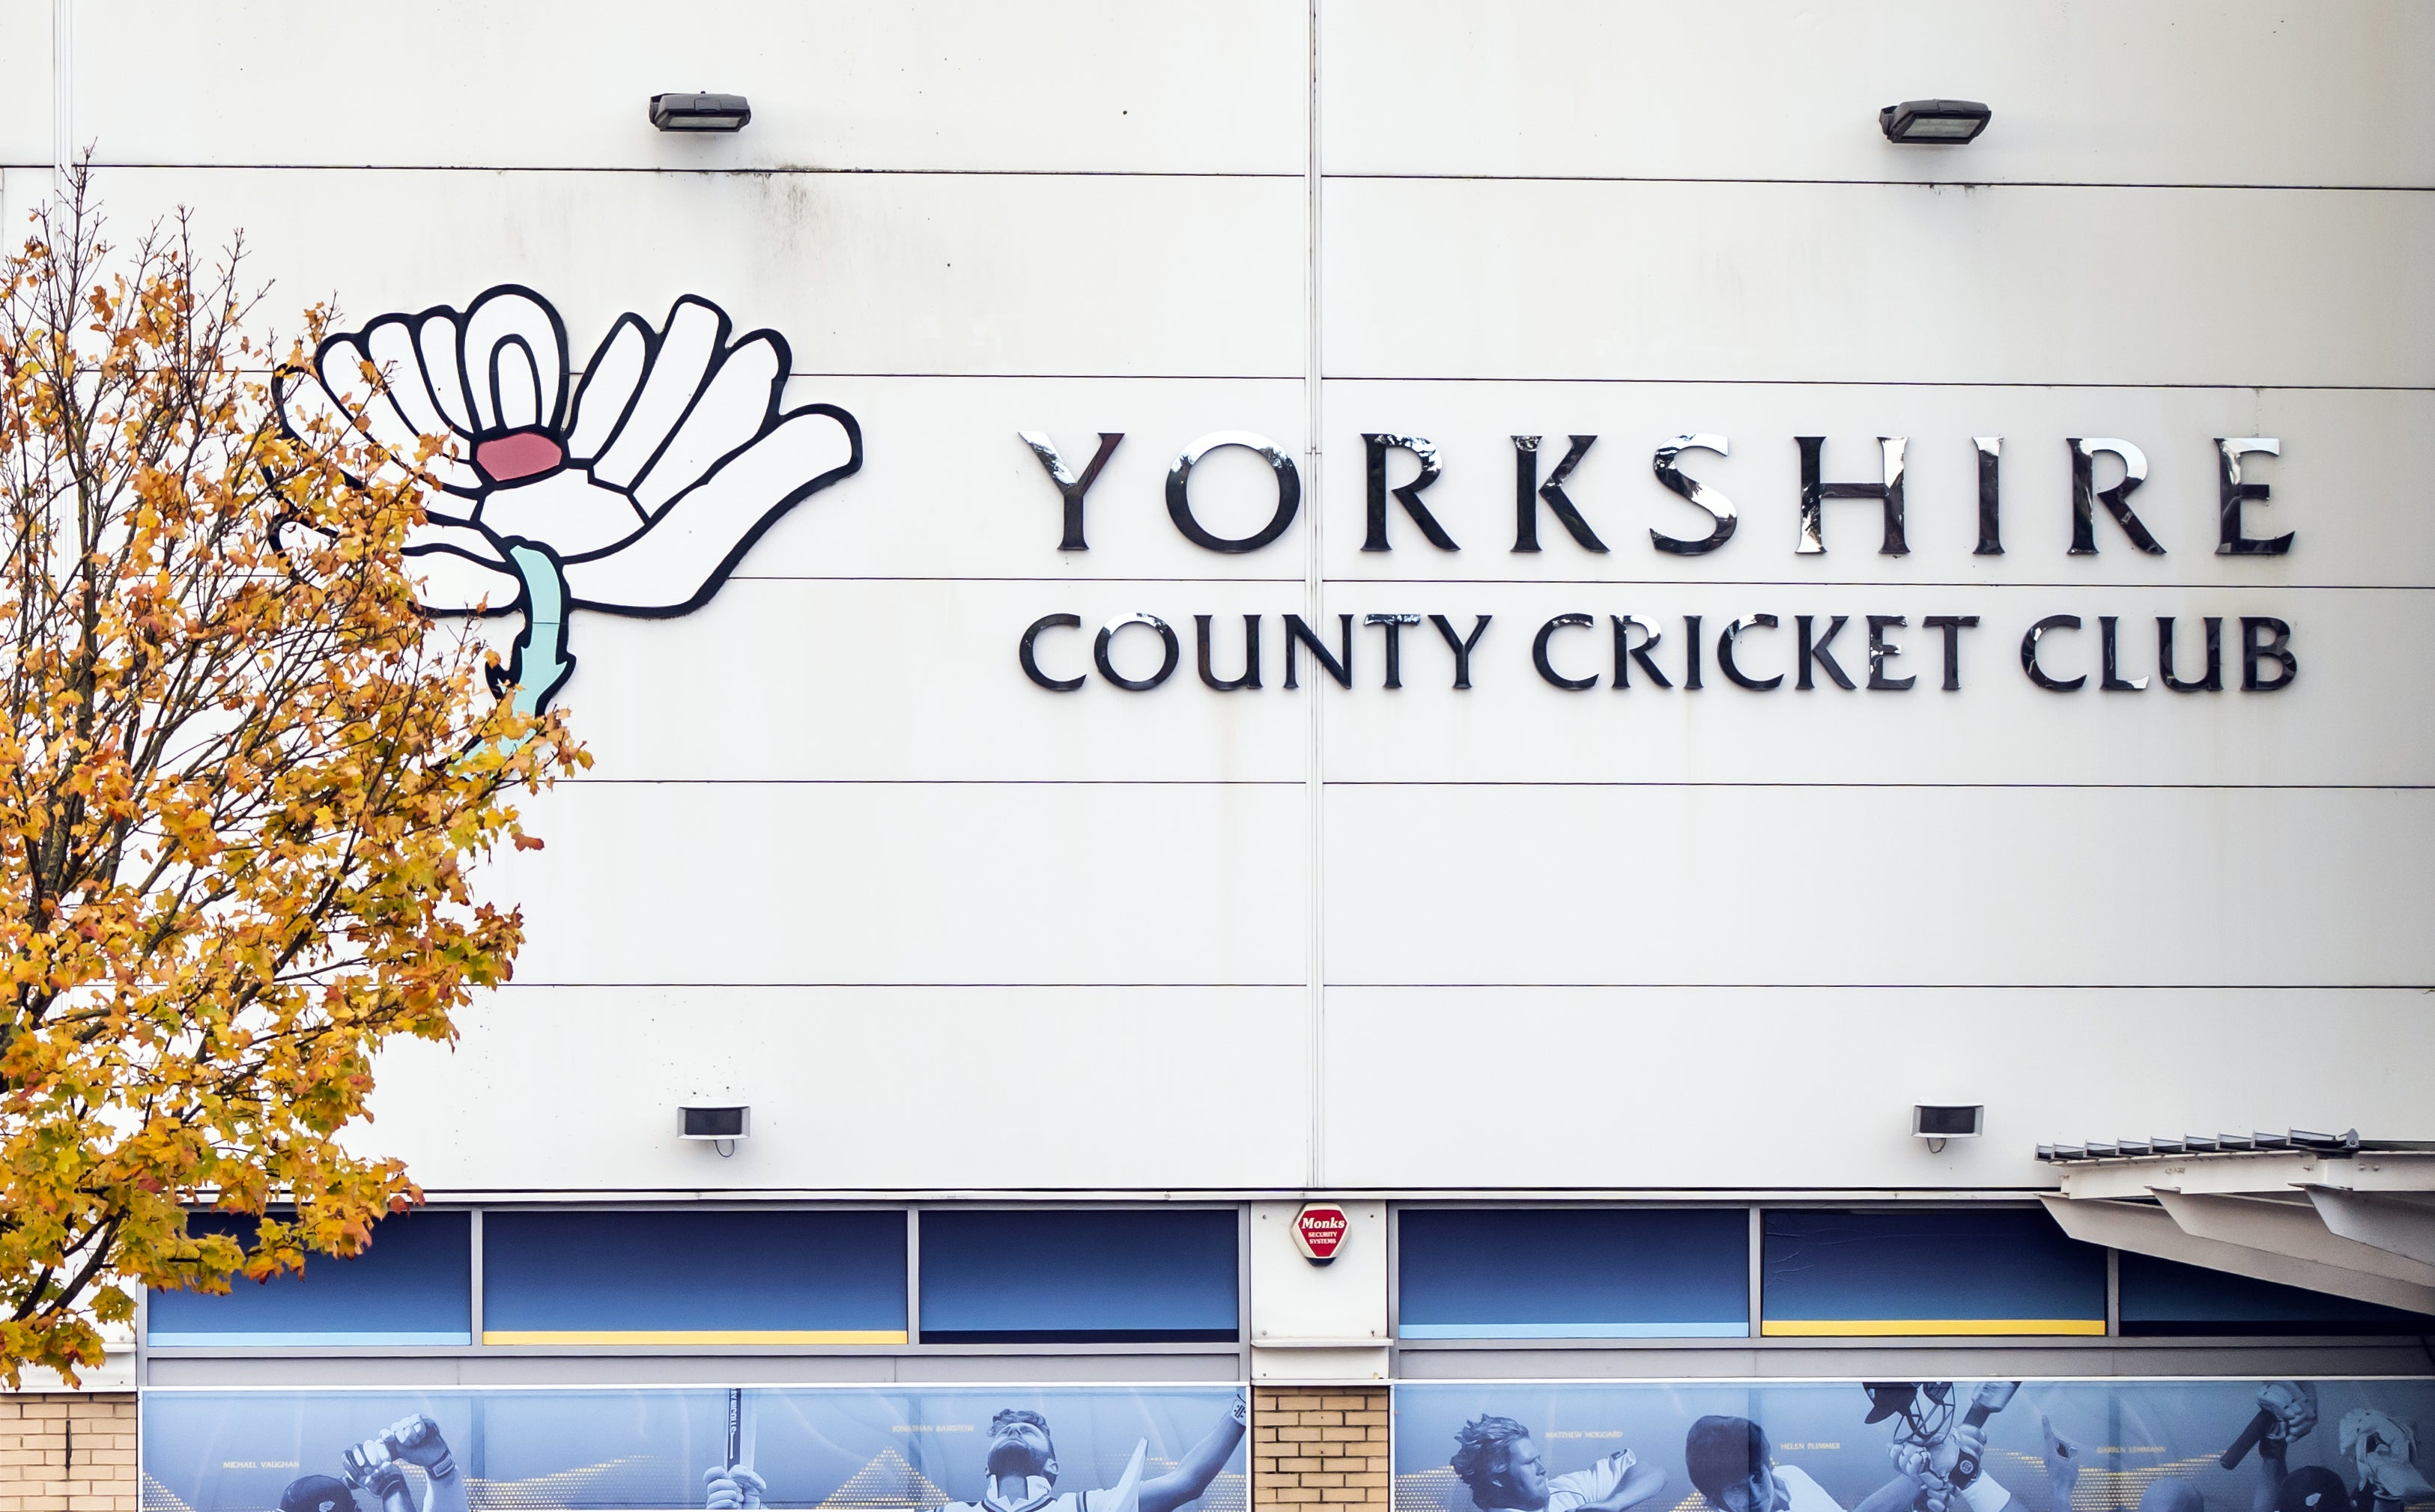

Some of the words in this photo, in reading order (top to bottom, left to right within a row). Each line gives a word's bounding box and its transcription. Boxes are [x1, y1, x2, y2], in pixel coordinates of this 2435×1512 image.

[1017, 429, 2296, 557] YORKSHIRE
[1019, 612, 1493, 692] COUNTY
[1532, 612, 1980, 692] CRICKET
[2020, 613, 2298, 692] CLUB
[1301, 1216, 1345, 1229] Monks
